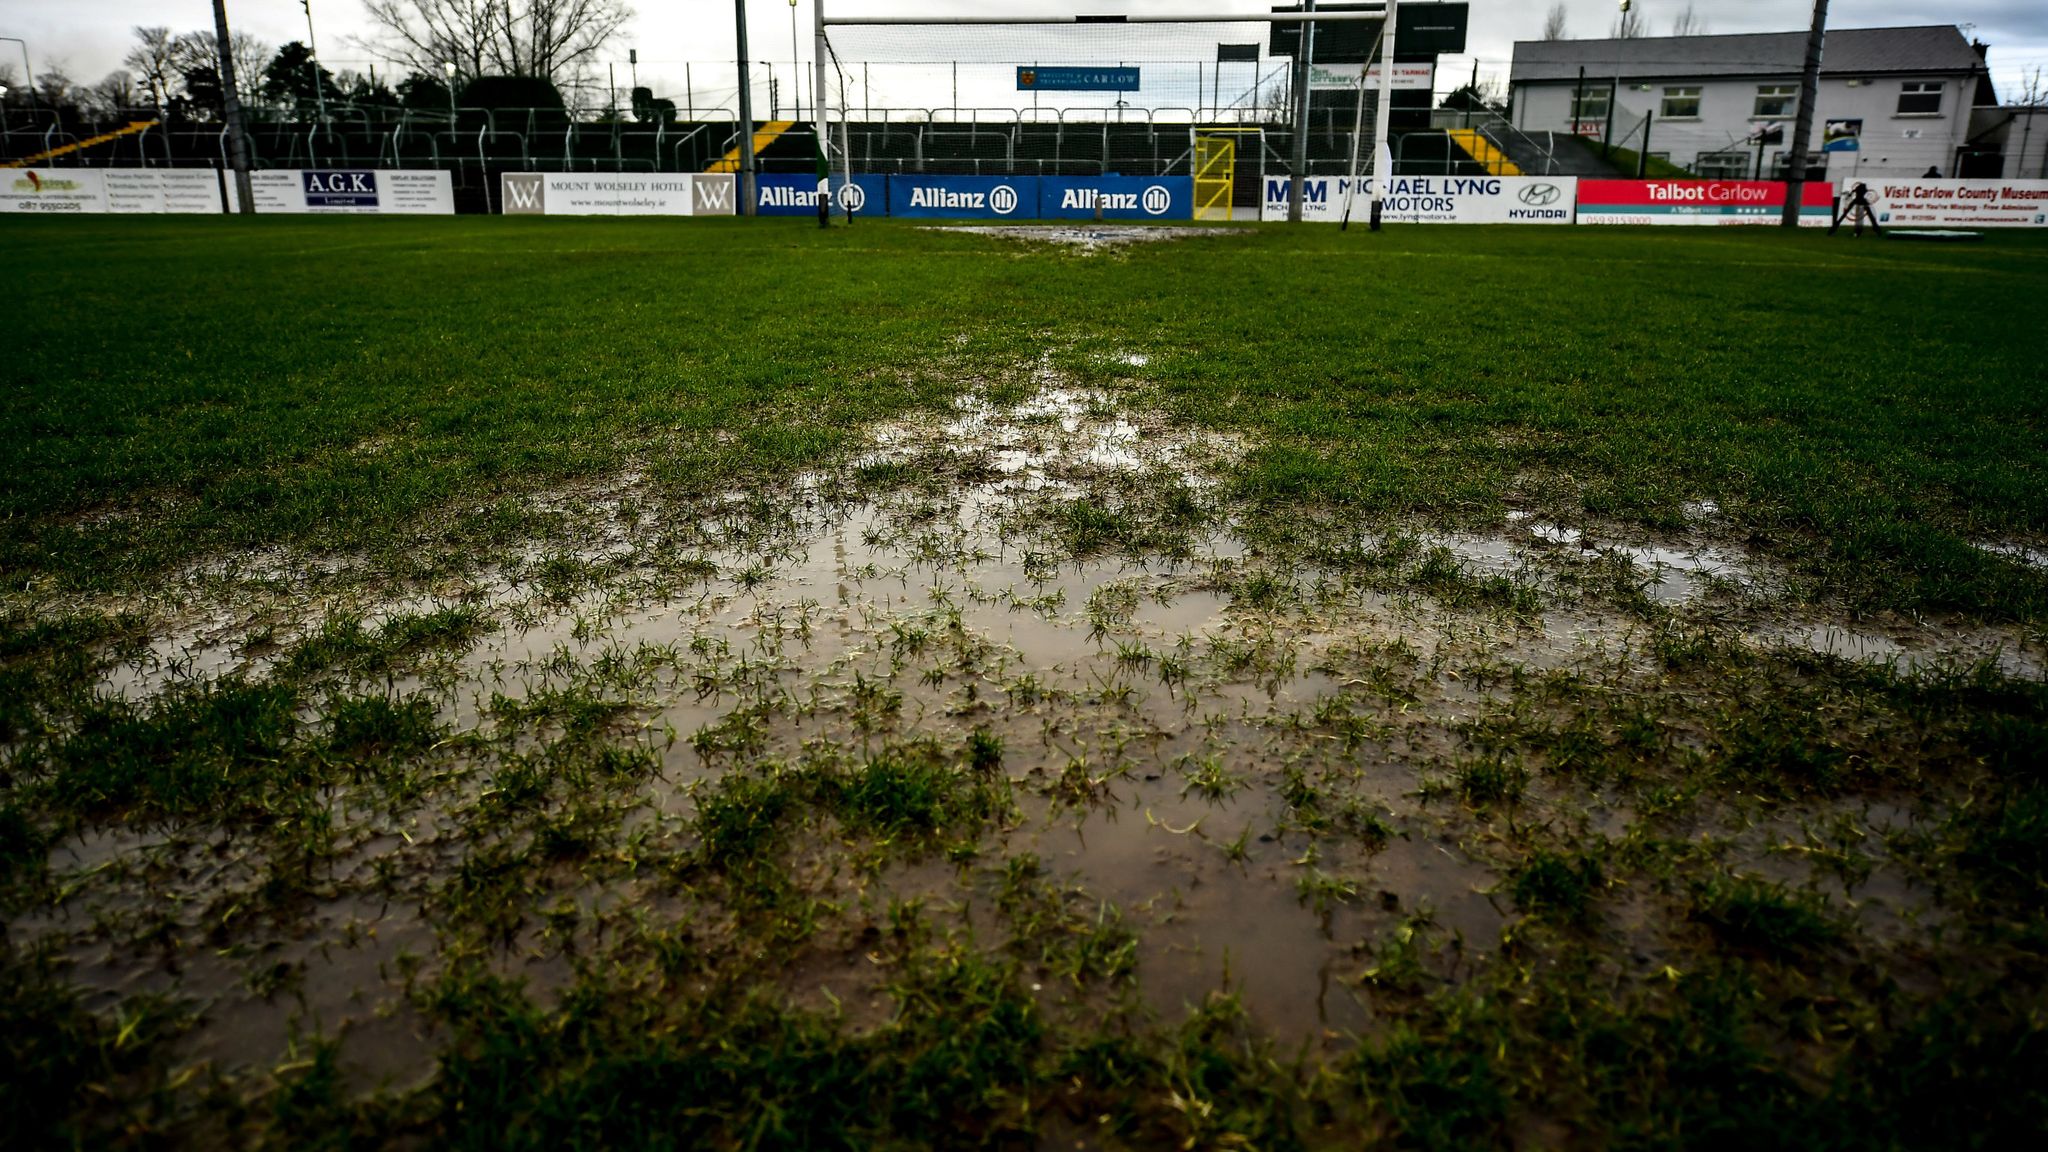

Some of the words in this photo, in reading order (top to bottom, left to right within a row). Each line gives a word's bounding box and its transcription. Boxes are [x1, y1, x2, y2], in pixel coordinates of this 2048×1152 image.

[1083, 74, 1136, 83] CARLOW
[309, 173, 374, 192] A.G.K.
[550, 182, 590, 191] MOUNT
[594, 182, 647, 191] WOLSELEY
[651, 182, 686, 192] HOTEL
[1444, 179, 1502, 196] LYNG
[910, 187, 985, 208] Allianz
[1646, 183, 1704, 200] Talbot
[1707, 183, 1768, 201] Carlow
[1884, 186, 1910, 198] Visit
[1913, 186, 1956, 199] Carlow
[1957, 187, 1999, 202] County
[2000, 187, 2048, 200] Museum
[570, 197, 667, 209] www.mountwolseley.ie
[1381, 197, 1454, 212] MOTORS
[1509, 208, 1567, 219] HYUNDAI
